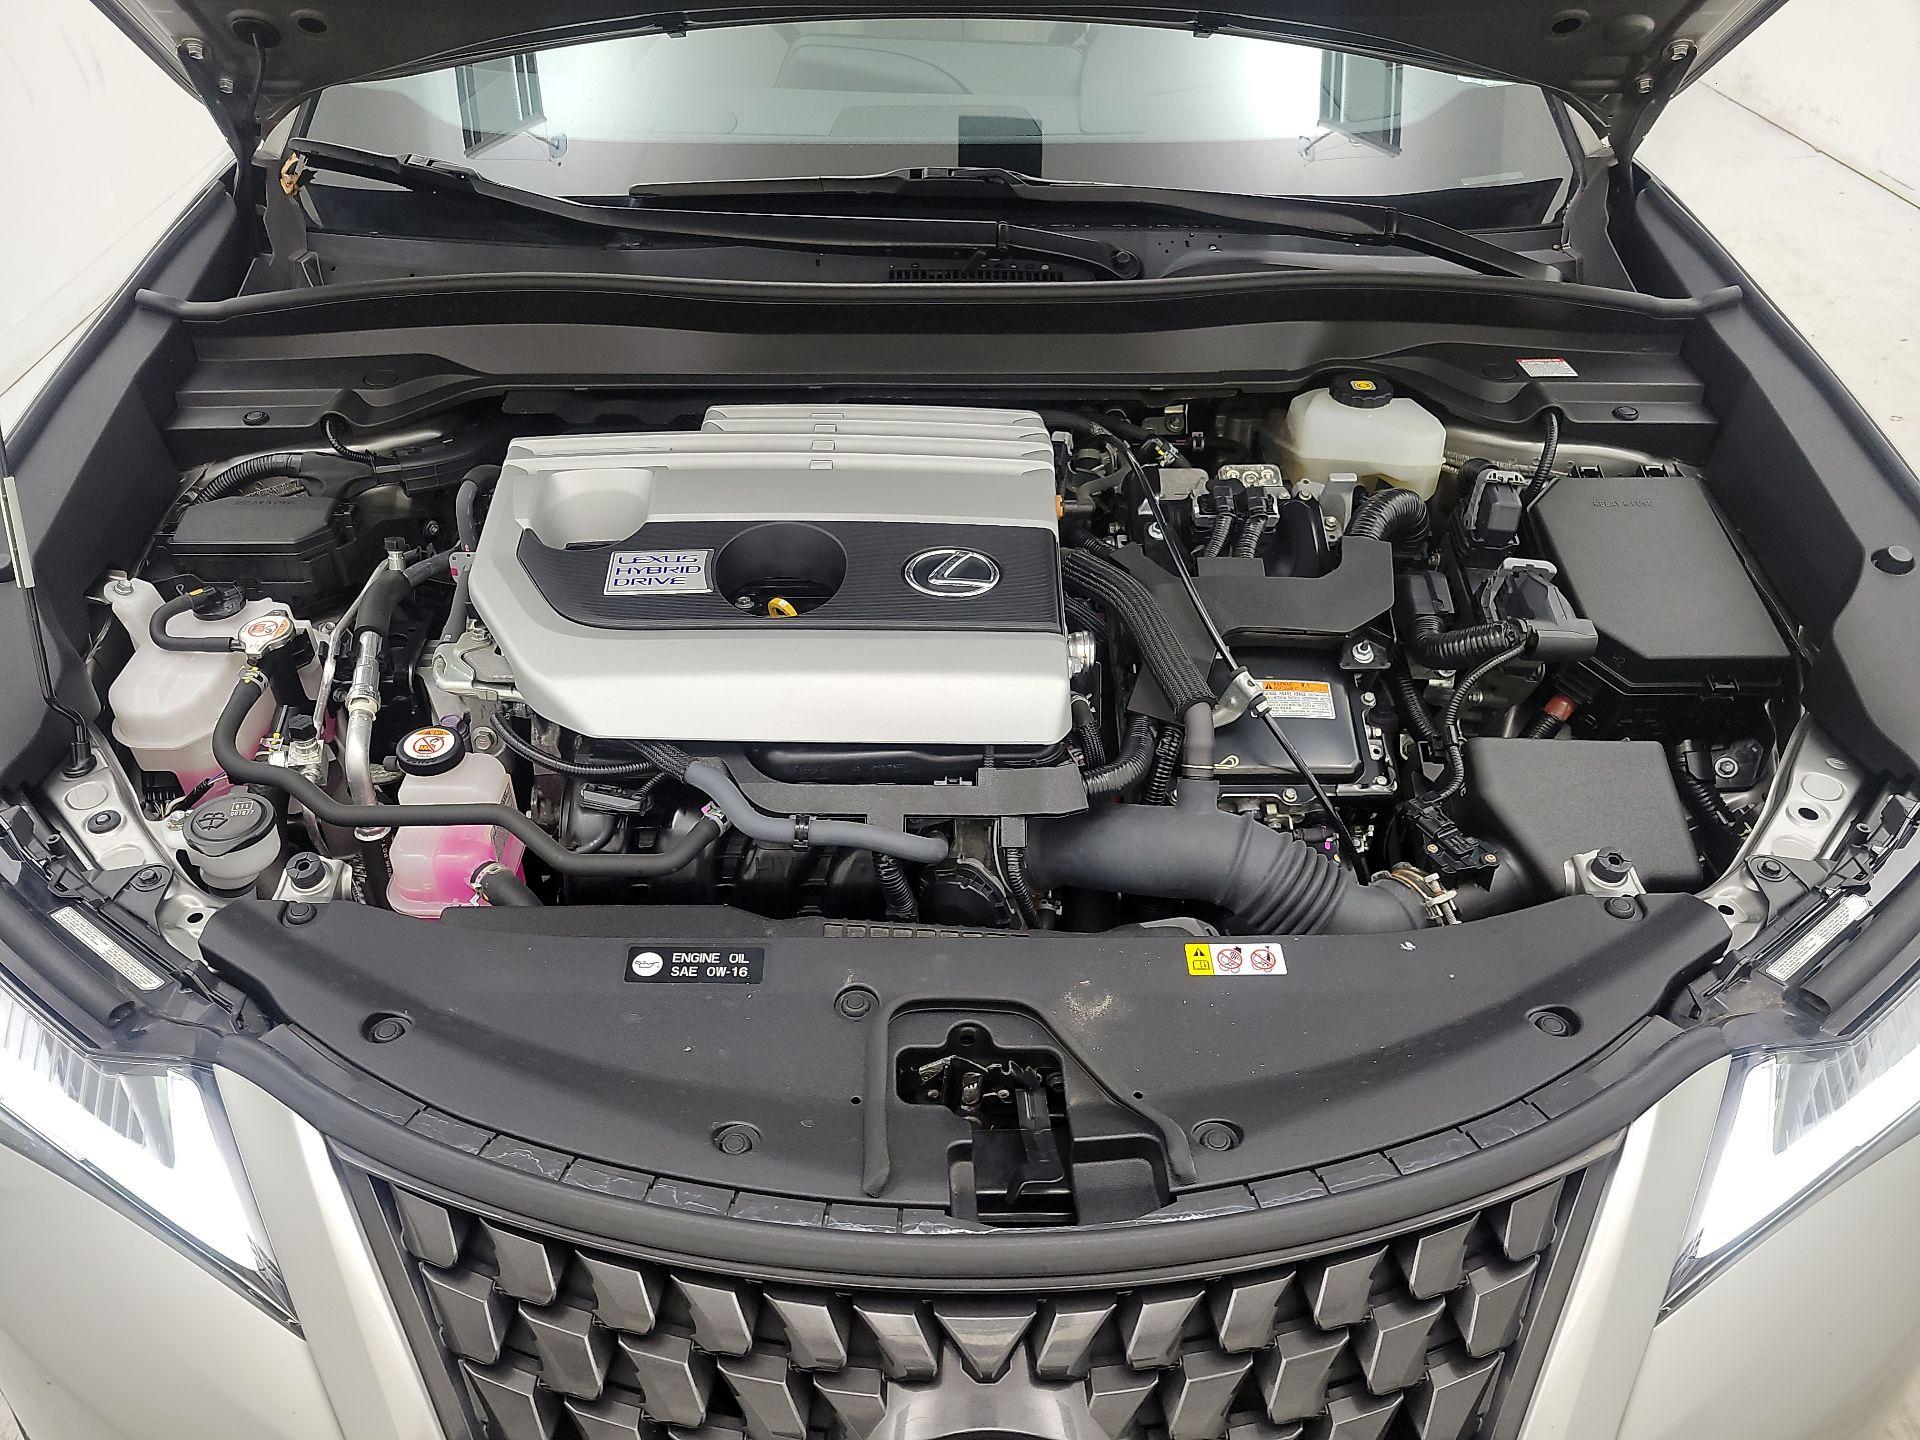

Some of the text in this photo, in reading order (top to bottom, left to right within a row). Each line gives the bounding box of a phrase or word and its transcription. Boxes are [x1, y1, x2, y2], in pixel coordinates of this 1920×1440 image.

[618, 554, 699, 565] LEXUS
[615, 565, 702, 576] HYBRID
[613, 576, 687, 587] DRIVE
[671, 952, 750, 964] ENGINE OIL
[670, 965, 749, 978] SAE 0W-16
